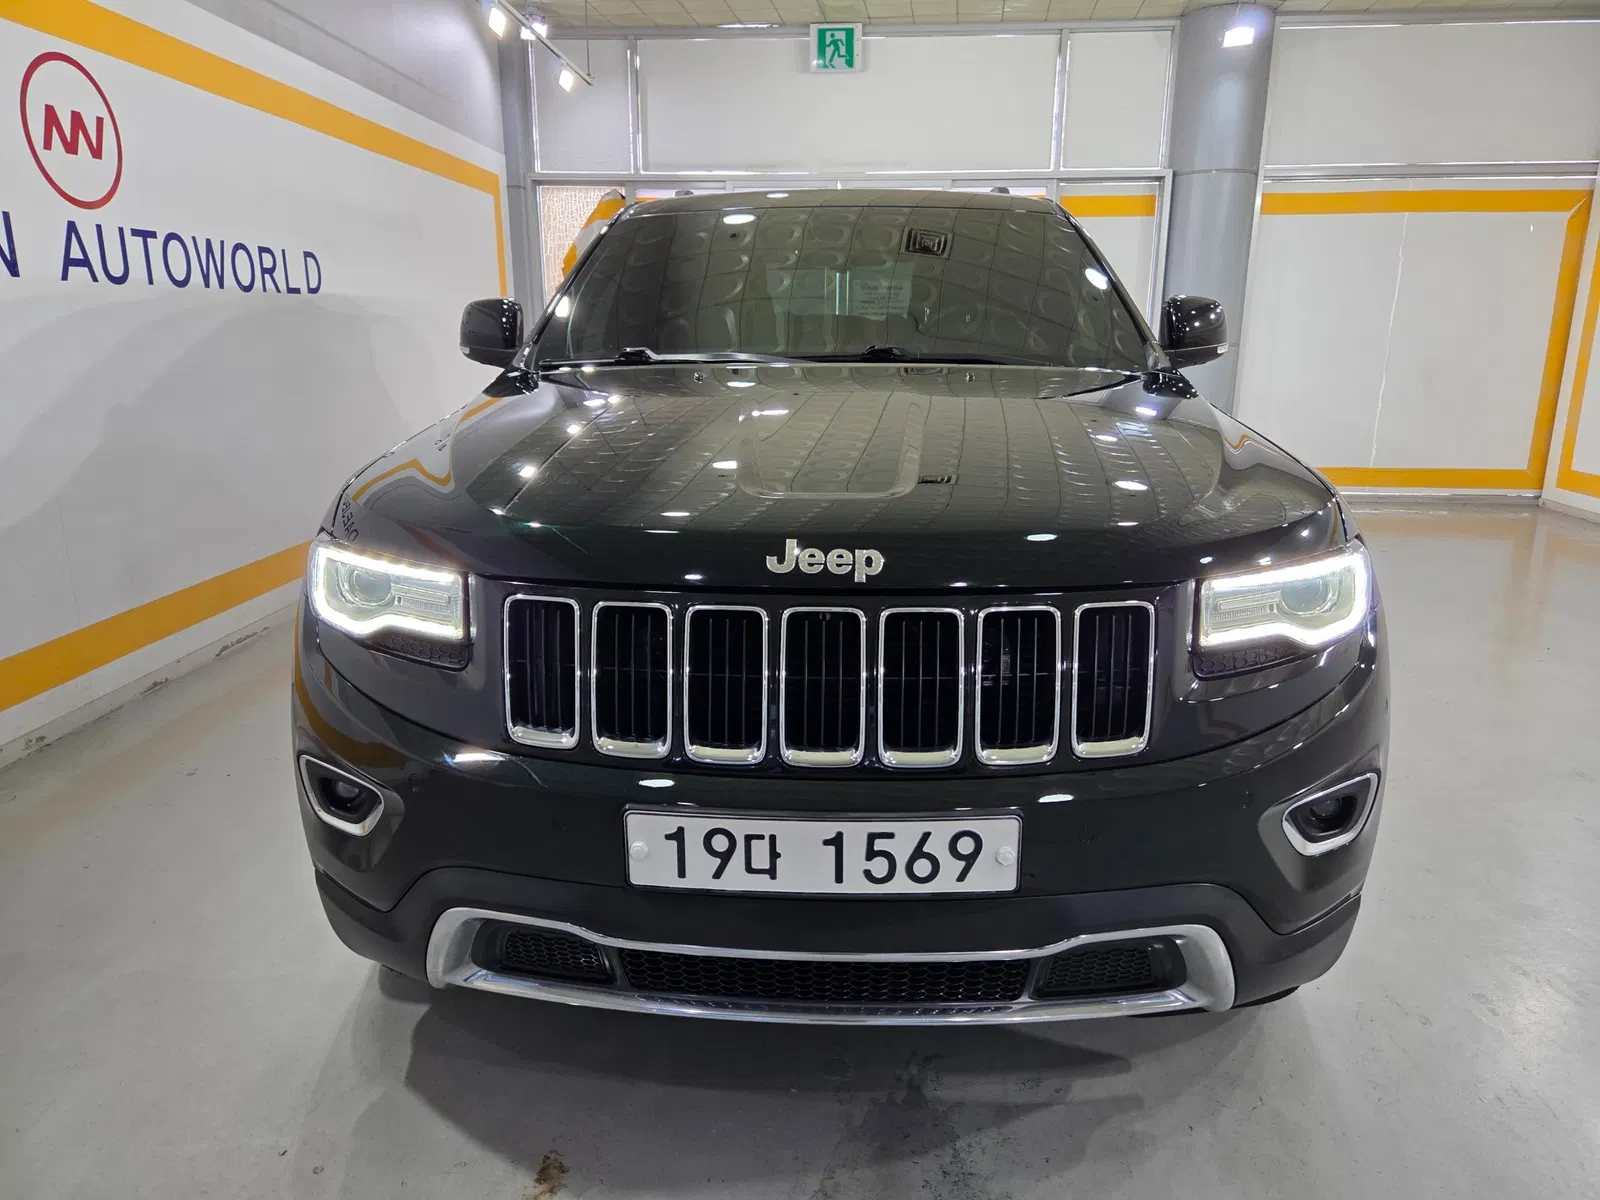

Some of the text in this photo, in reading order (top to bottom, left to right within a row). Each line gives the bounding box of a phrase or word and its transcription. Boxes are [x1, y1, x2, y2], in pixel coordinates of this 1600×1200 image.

[61, 219, 323, 295] AUTOWORLD
[766, 538, 885, 583] Jeep
[664, 825, 984, 885] 19다 1569
